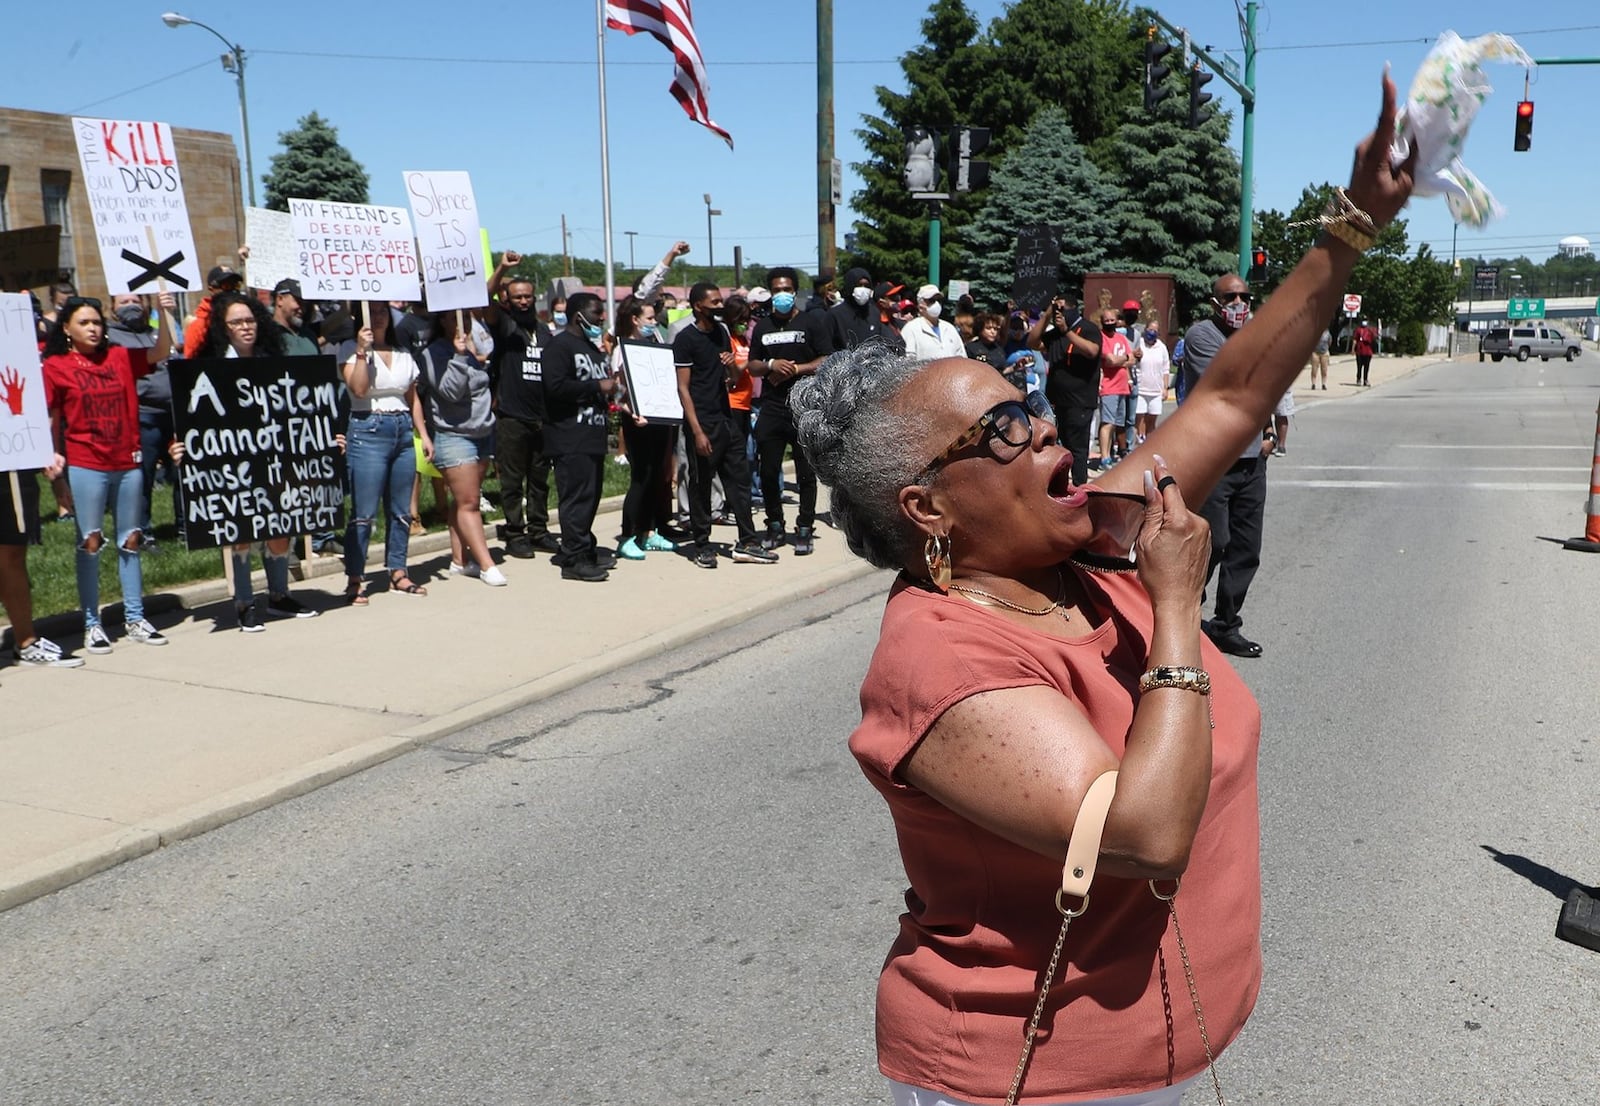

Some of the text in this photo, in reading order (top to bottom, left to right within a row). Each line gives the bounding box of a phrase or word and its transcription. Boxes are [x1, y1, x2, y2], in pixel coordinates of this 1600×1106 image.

[118, 165, 178, 193] DADS
[127, 194, 158, 210] make
[161, 195, 182, 209] fun
[292, 200, 402, 226] MY FRIENDS
[99, 233, 143, 253] having
[309, 222, 382, 237] DESERVE
[434, 219, 467, 251] IS
[298, 238, 410, 254] TO FEEL AS SAFE
[300, 252, 416, 278] AND RESPECTED
[317, 279, 382, 293] AS I DO
[187, 371, 227, 417] A
[184, 418, 284, 461] cannot
[183, 454, 335, 493] those it was
[188, 487, 274, 523] NEVER
[252, 506, 338, 539] PROTECT
